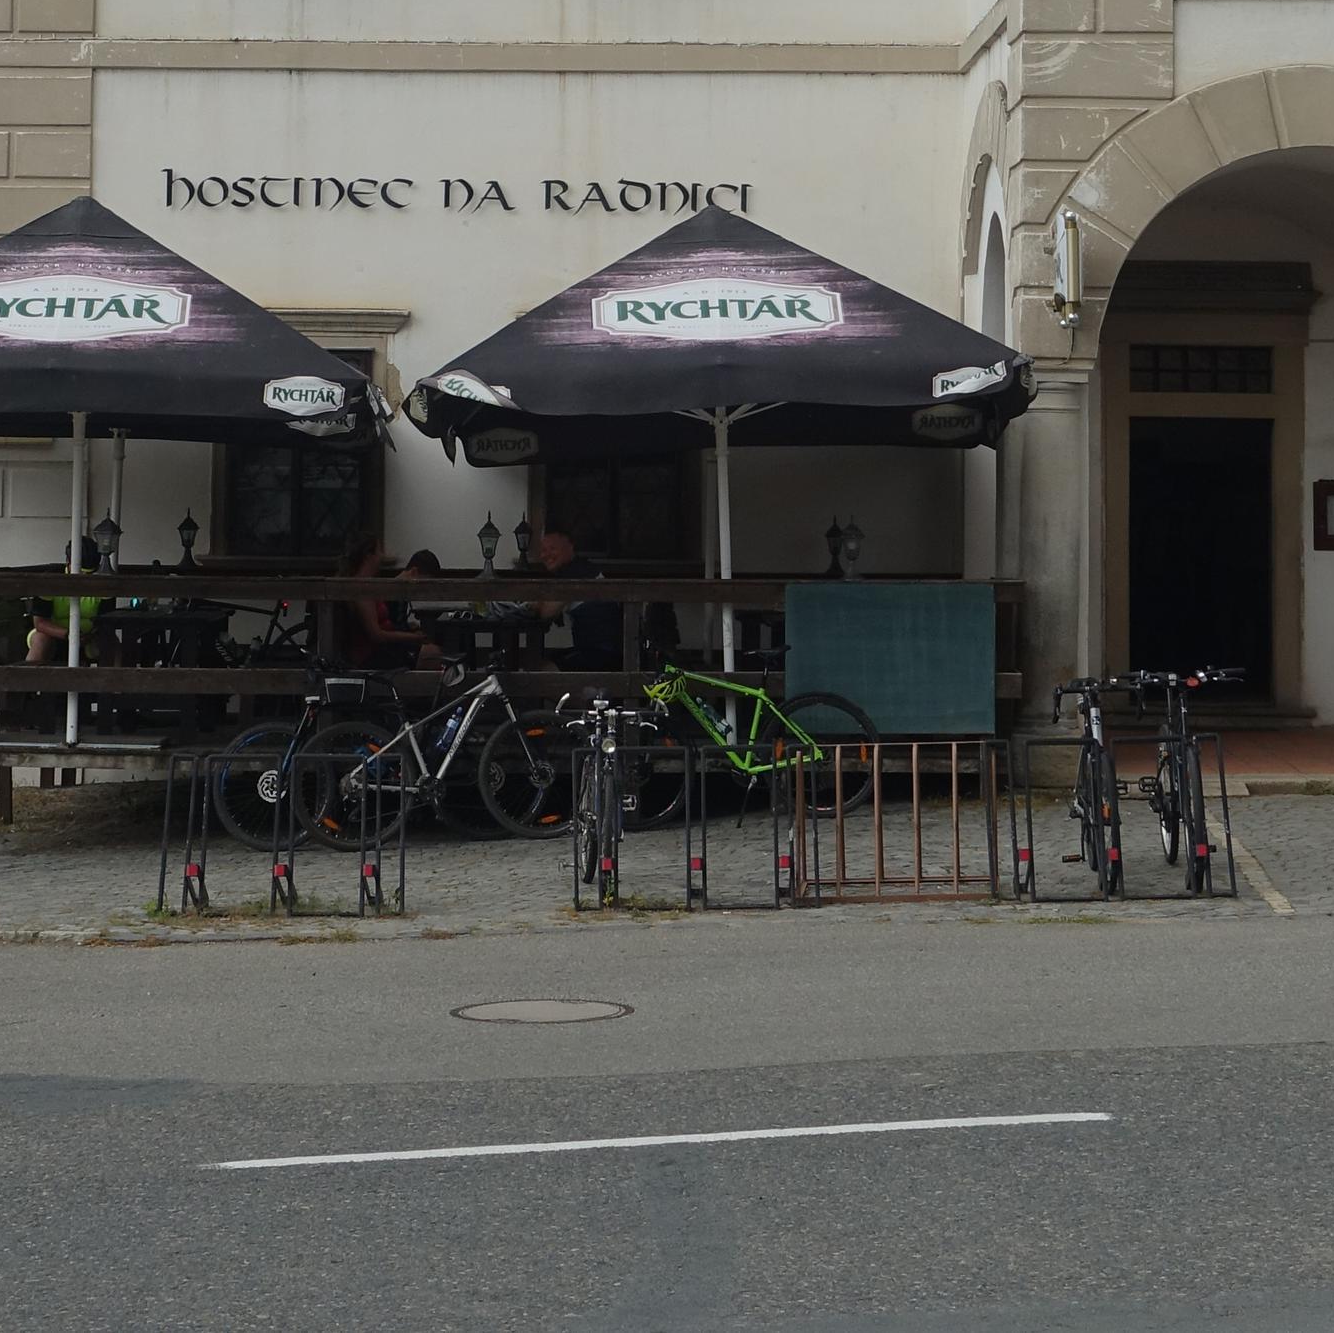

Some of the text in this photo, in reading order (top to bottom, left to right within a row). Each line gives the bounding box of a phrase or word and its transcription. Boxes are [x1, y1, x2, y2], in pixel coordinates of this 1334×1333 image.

[440, 178, 515, 212] NA
[617, 293, 826, 325] RYCHTÁŘ
[272, 386, 338, 407] RYCHTÁŘ
